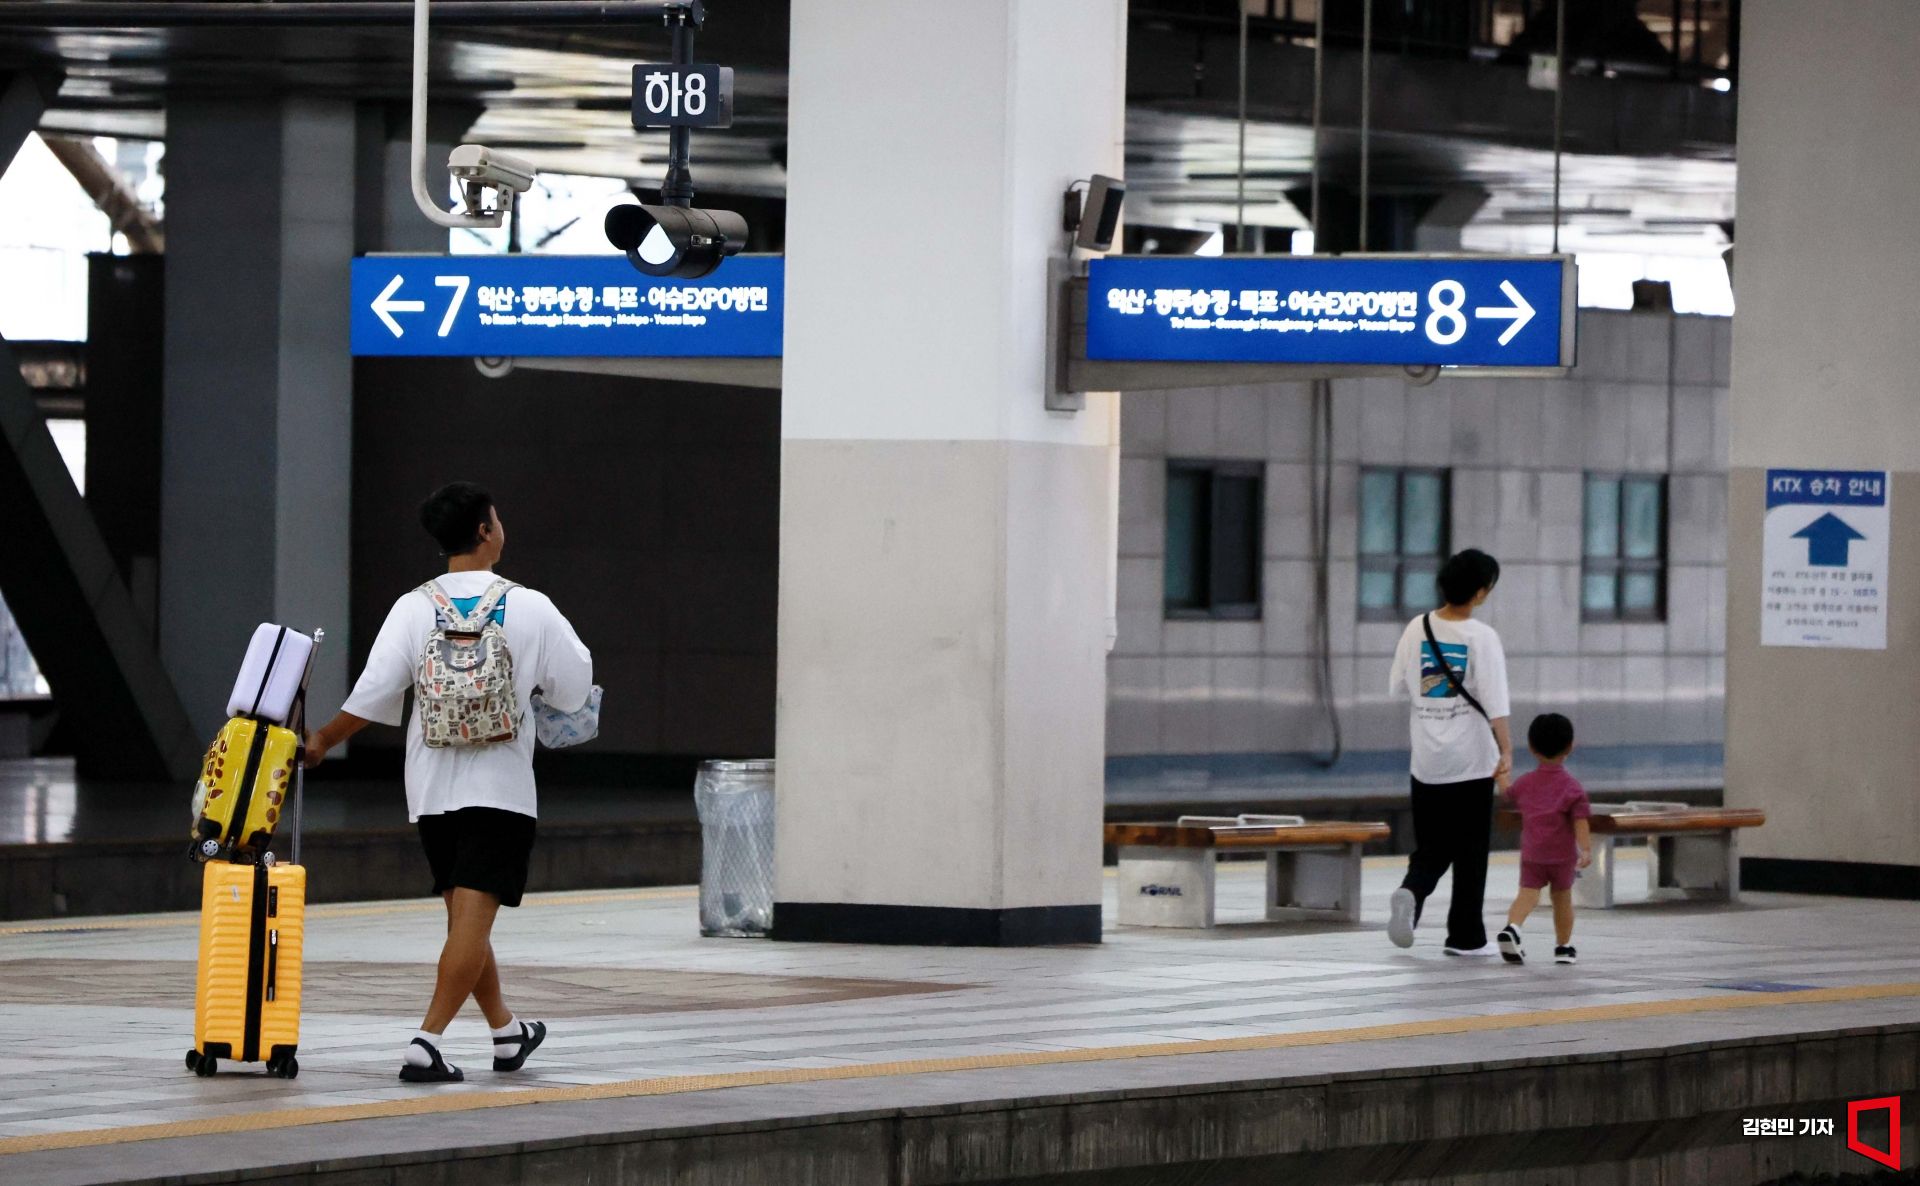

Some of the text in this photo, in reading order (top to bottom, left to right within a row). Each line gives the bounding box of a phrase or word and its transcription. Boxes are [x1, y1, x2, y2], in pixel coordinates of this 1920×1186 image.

[645, 71, 706, 117] 하8
[434, 275, 470, 337] 7
[1424, 279, 1467, 345] 8
[1772, 478, 1802, 493] KTX
[1848, 478, 1881, 497] 안내
